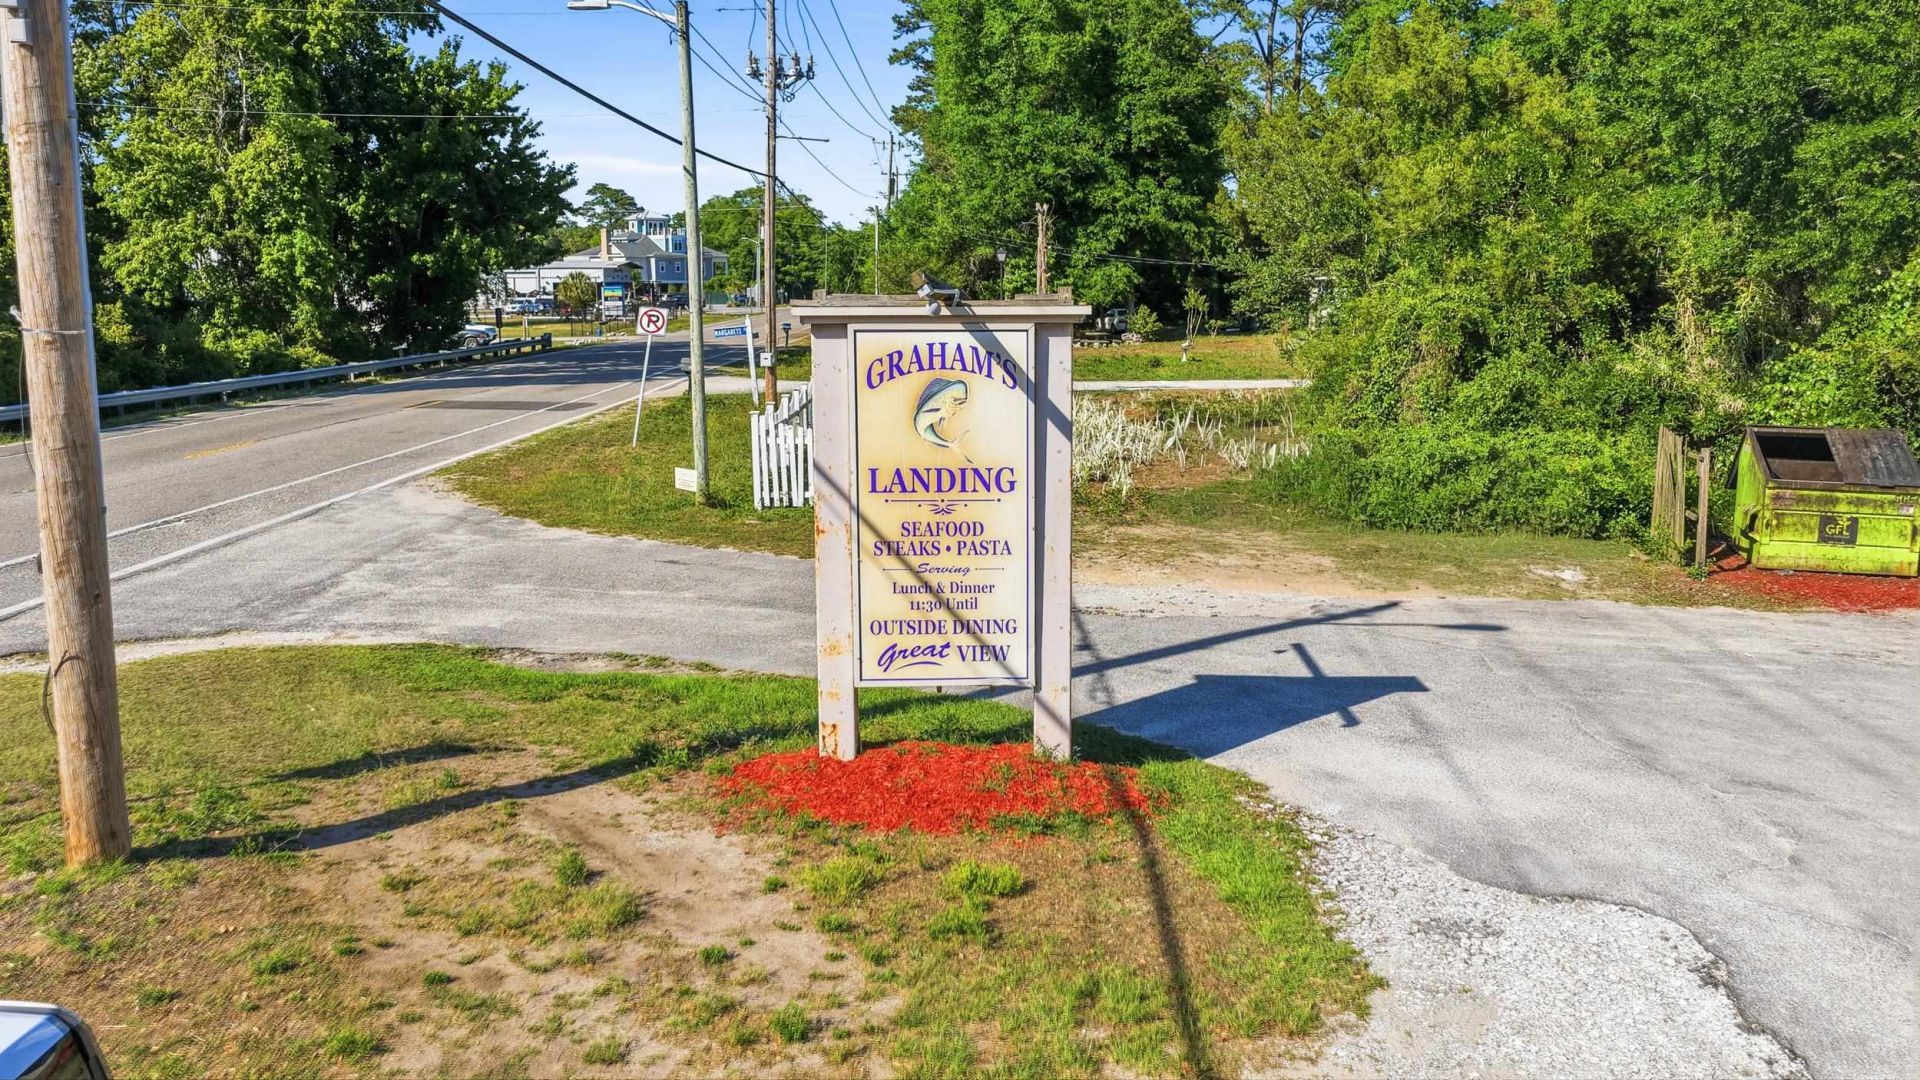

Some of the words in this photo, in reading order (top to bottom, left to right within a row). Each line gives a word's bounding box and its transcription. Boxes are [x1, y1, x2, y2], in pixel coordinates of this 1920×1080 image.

[866, 342, 1018, 390] GRAHAM'S
[868, 467, 1018, 494] LANDING
[900, 521, 985, 537] SEAFOOD
[1825, 524, 1850, 535] GFL
[873, 541, 941, 556] STEAKS
[956, 540, 1012, 556] PASTA
[916, 563, 971, 576] Serving
[892, 582, 932, 595] Lunch
[936, 582, 946, 595] &
[949, 582, 996, 594] Dinner
[909, 600, 942, 613] 11:30
[946, 597, 978, 610] Until
[870, 619, 948, 636] OUTSIDE
[952, 619, 1018, 635] DINING
[877, 641, 952, 673] Great
[956, 645, 1010, 662] VIEW
